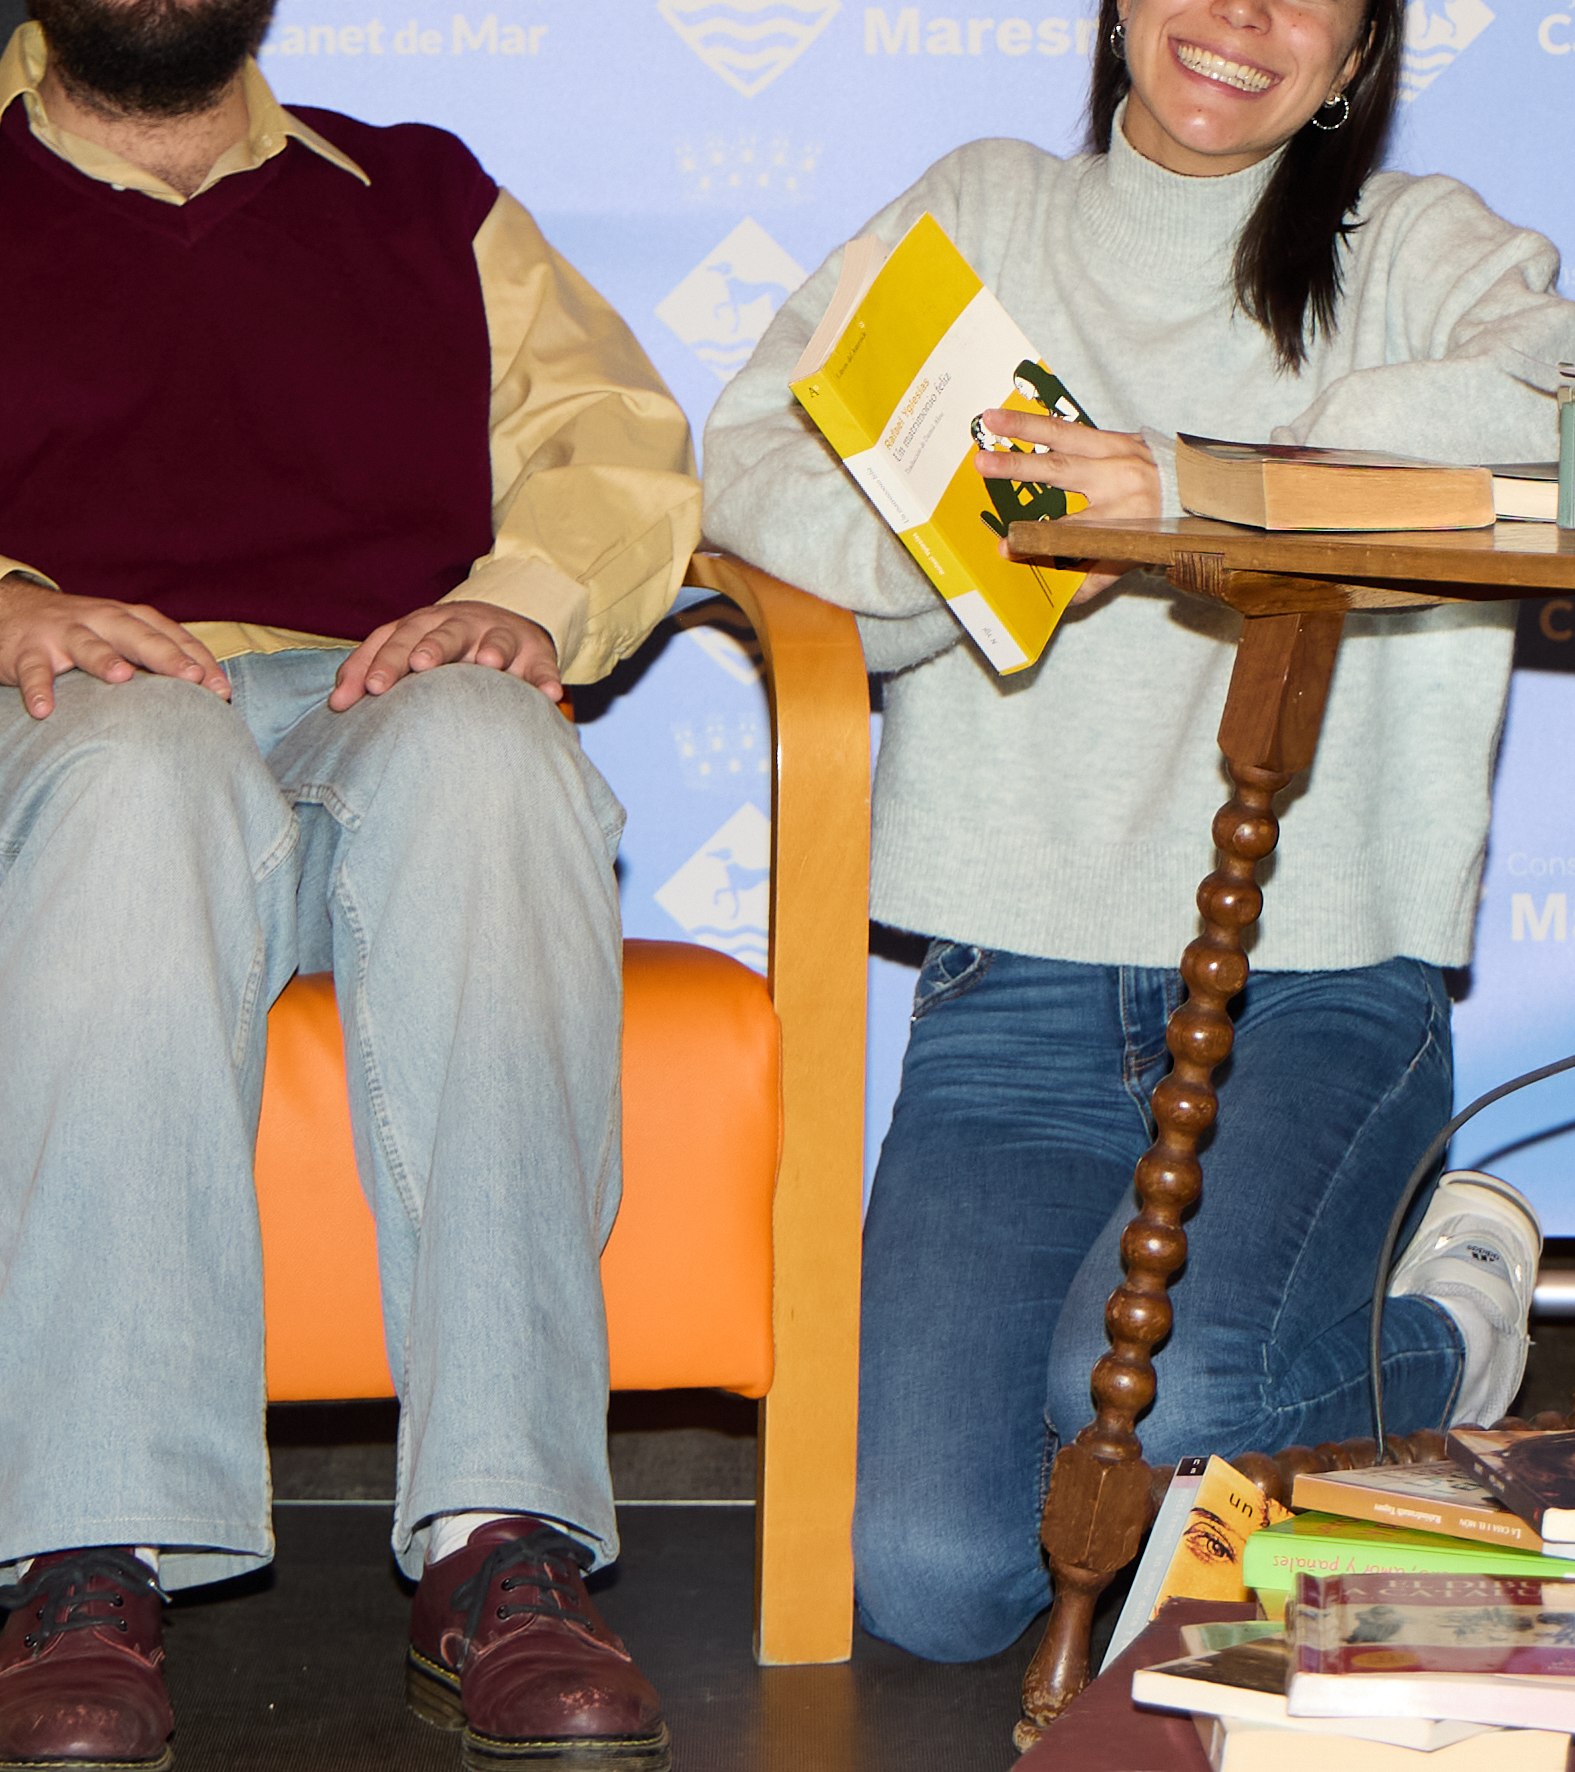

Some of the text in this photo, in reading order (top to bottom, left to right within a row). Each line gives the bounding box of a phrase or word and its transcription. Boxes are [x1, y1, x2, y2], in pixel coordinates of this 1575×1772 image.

[394, 20, 442, 54] de
[453, 15, 548, 54] Mar
[865, 8, 1100, 55] Mares
[884, 416, 906, 450] Rafael
[901, 378, 930, 418] Yglesias
[892, 446, 906, 462] Un
[902, 393, 938, 447] matrimonio
[933, 372, 952, 395] feliz
[1229, 1493, 1254, 1518] un
[1273, 1553, 1356, 1574] y pañales
